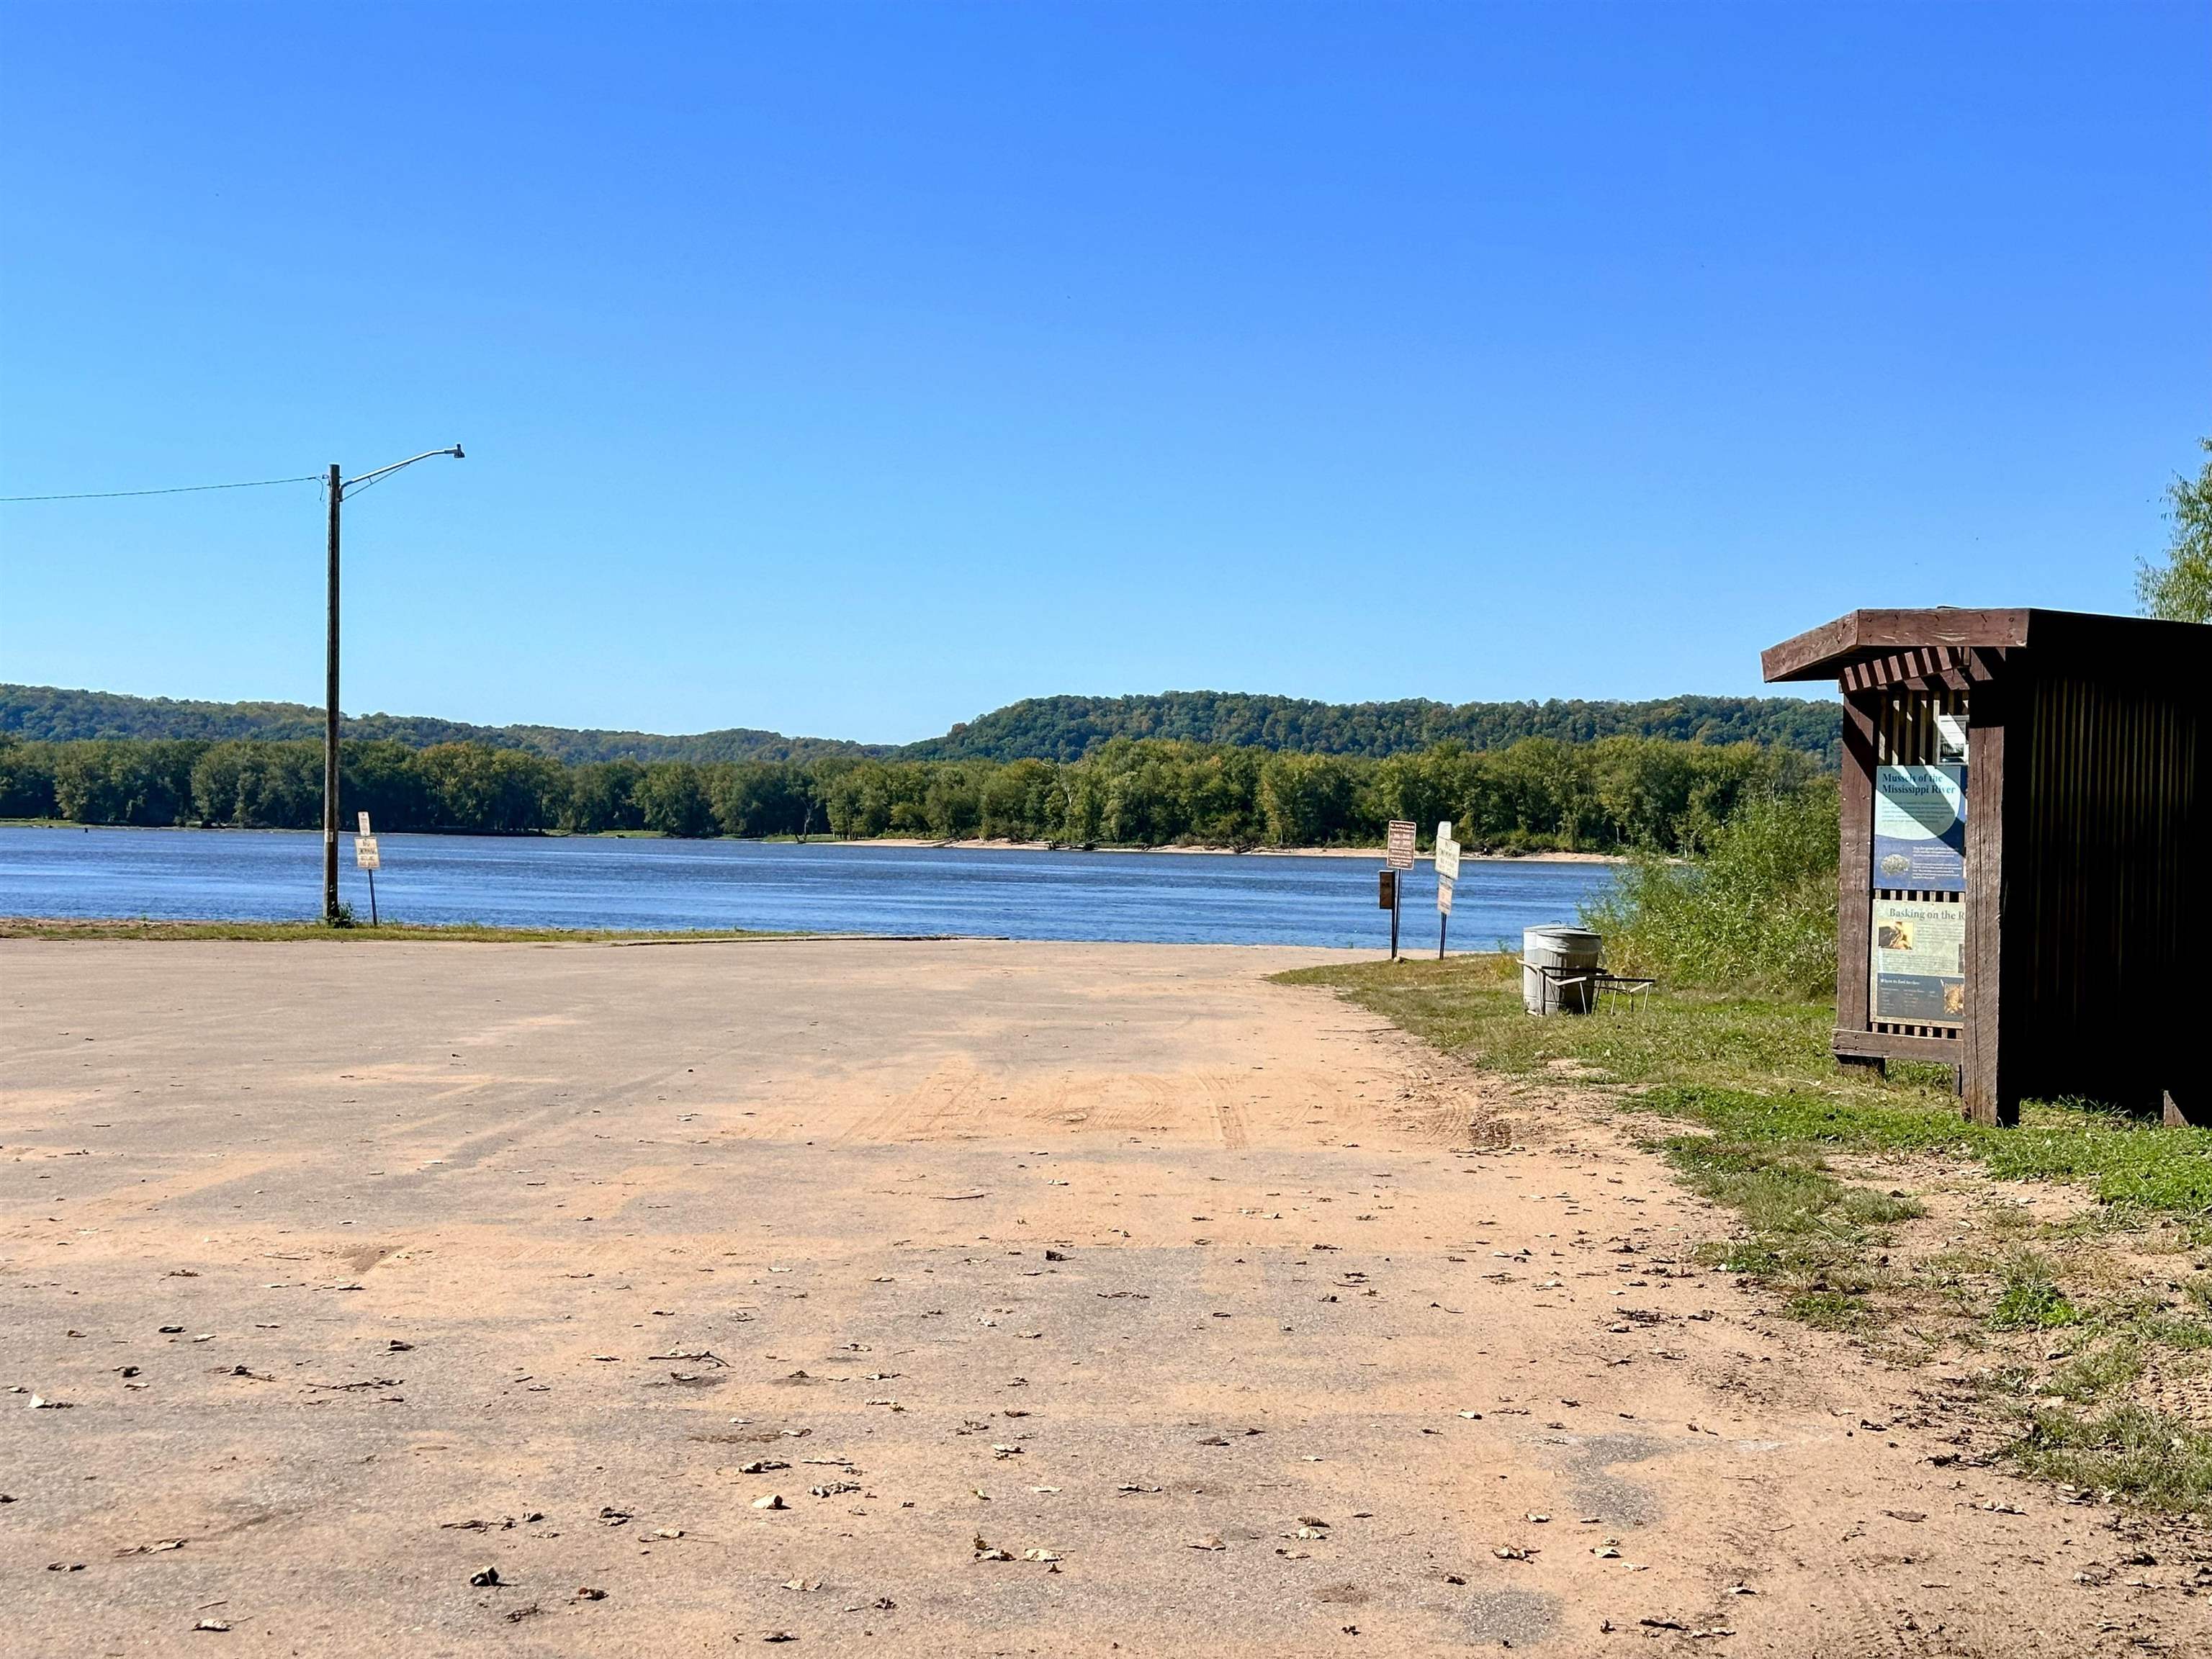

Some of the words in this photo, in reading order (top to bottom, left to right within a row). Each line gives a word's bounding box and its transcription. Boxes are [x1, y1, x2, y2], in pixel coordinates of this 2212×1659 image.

[1882, 773, 1916, 782] Mussels
[1918, 773, 1928, 782] of
[1929, 773, 1943, 783] the
[1882, 784, 1929, 795] Mississippi
[1931, 785, 1956, 794] River
[1889, 908, 1925, 921] Basking
[1941, 909, 1956, 920] the
